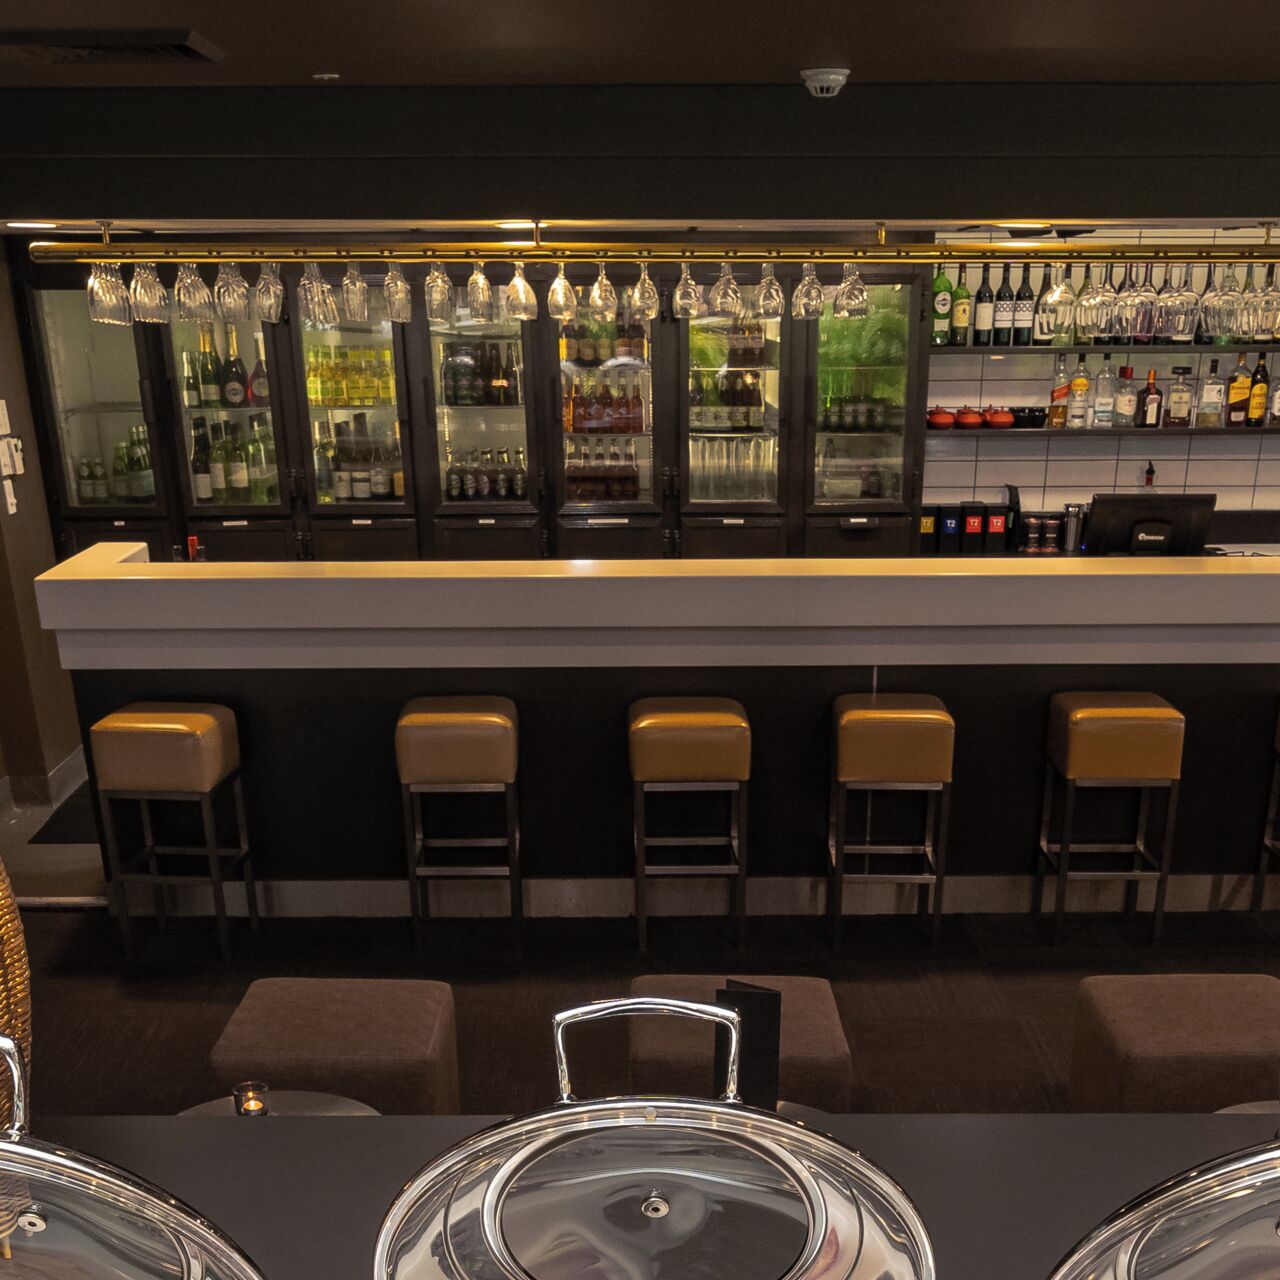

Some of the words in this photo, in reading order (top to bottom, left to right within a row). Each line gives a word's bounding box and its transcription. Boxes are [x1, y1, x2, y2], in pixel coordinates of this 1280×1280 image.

[922, 519, 931, 527] T2
[946, 519, 956, 527] T2
[969, 518, 978, 526] T2
[992, 518, 1001, 526] T2
